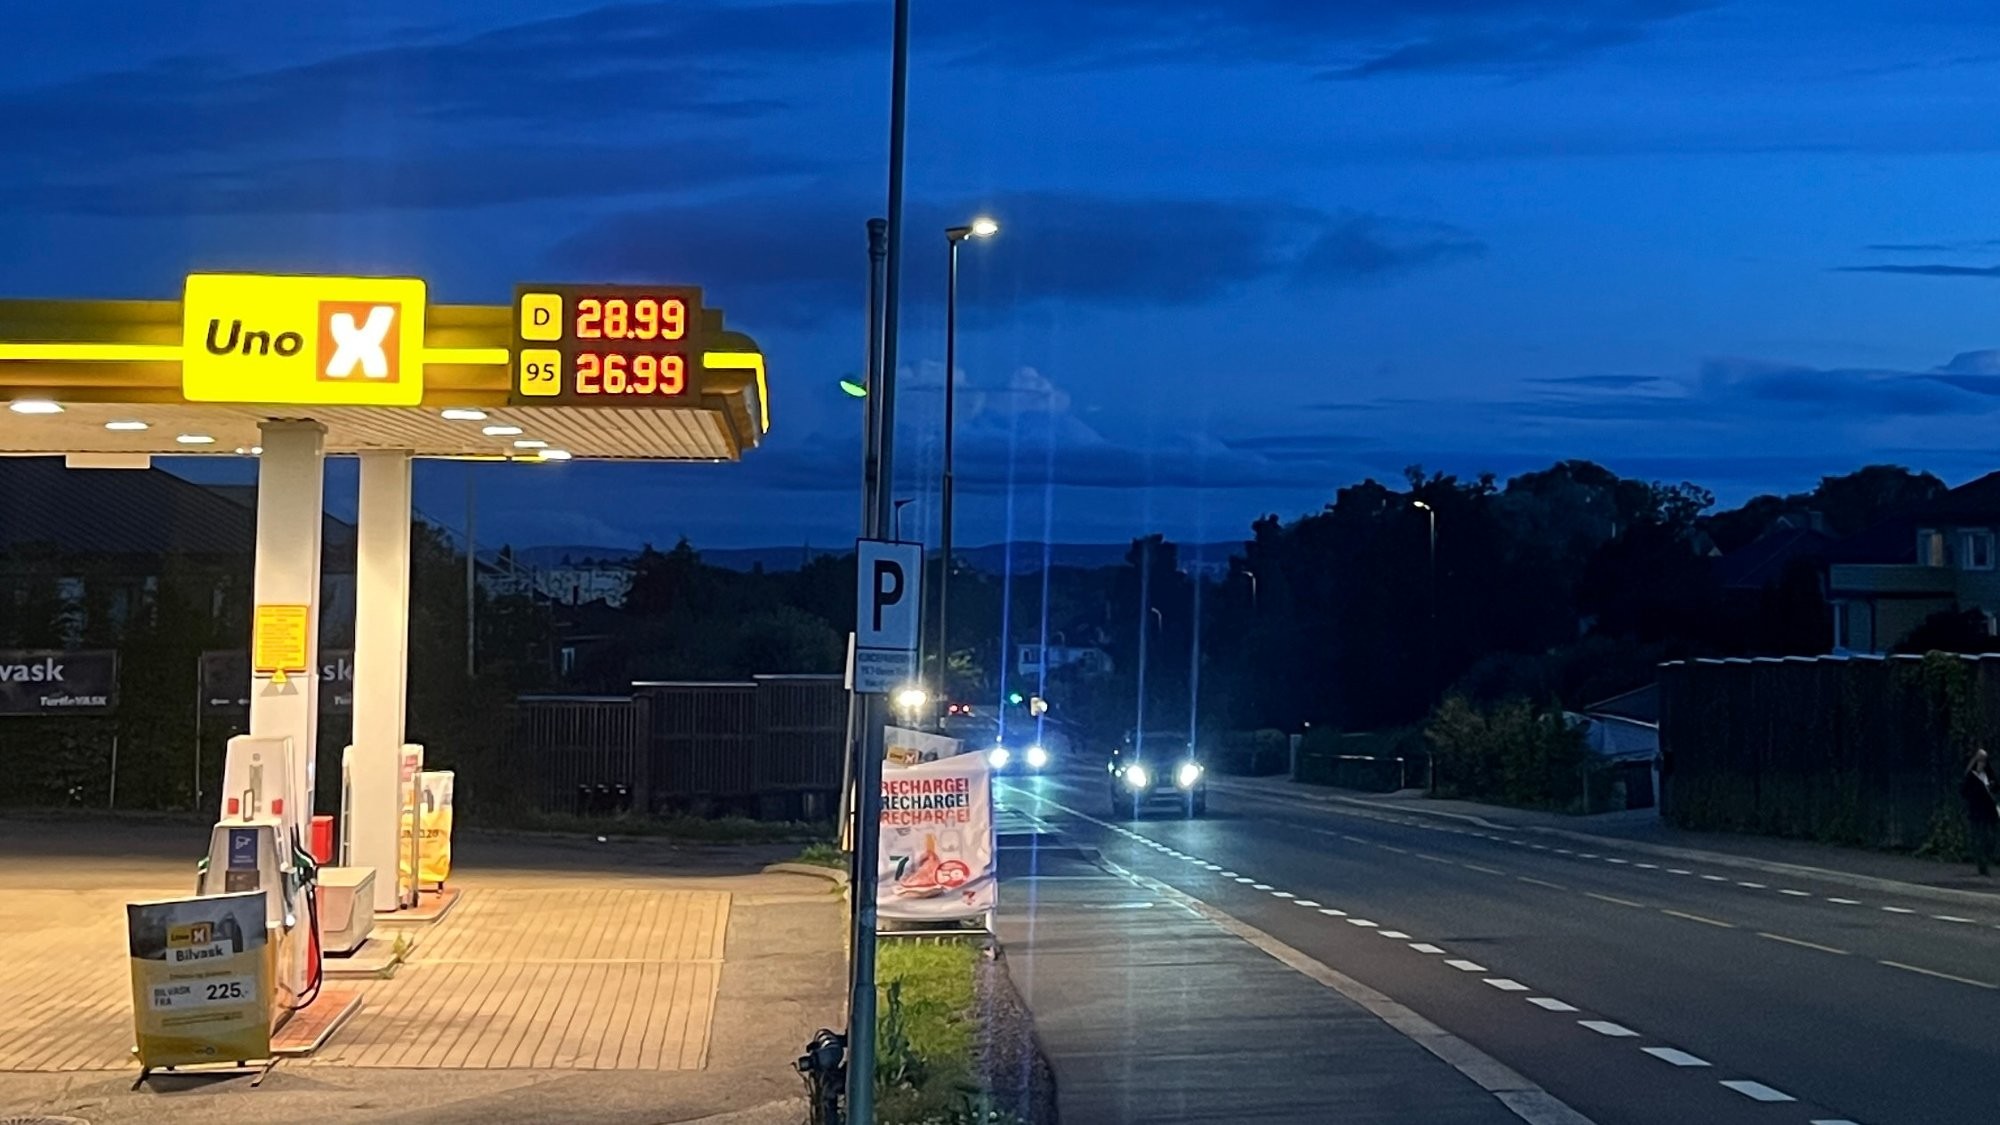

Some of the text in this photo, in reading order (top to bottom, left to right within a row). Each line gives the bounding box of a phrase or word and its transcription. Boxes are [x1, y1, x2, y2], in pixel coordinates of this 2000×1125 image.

[534, 299, 685, 340] D 28.99
[206, 305, 395, 378] Uno X
[527, 353, 684, 394] 95 26.99
[873, 560, 904, 631] P
[880, 778, 969, 795] RECHARGE!
[881, 793, 969, 810] RECHARGE!
[176, 944, 224, 962] Bilvask
